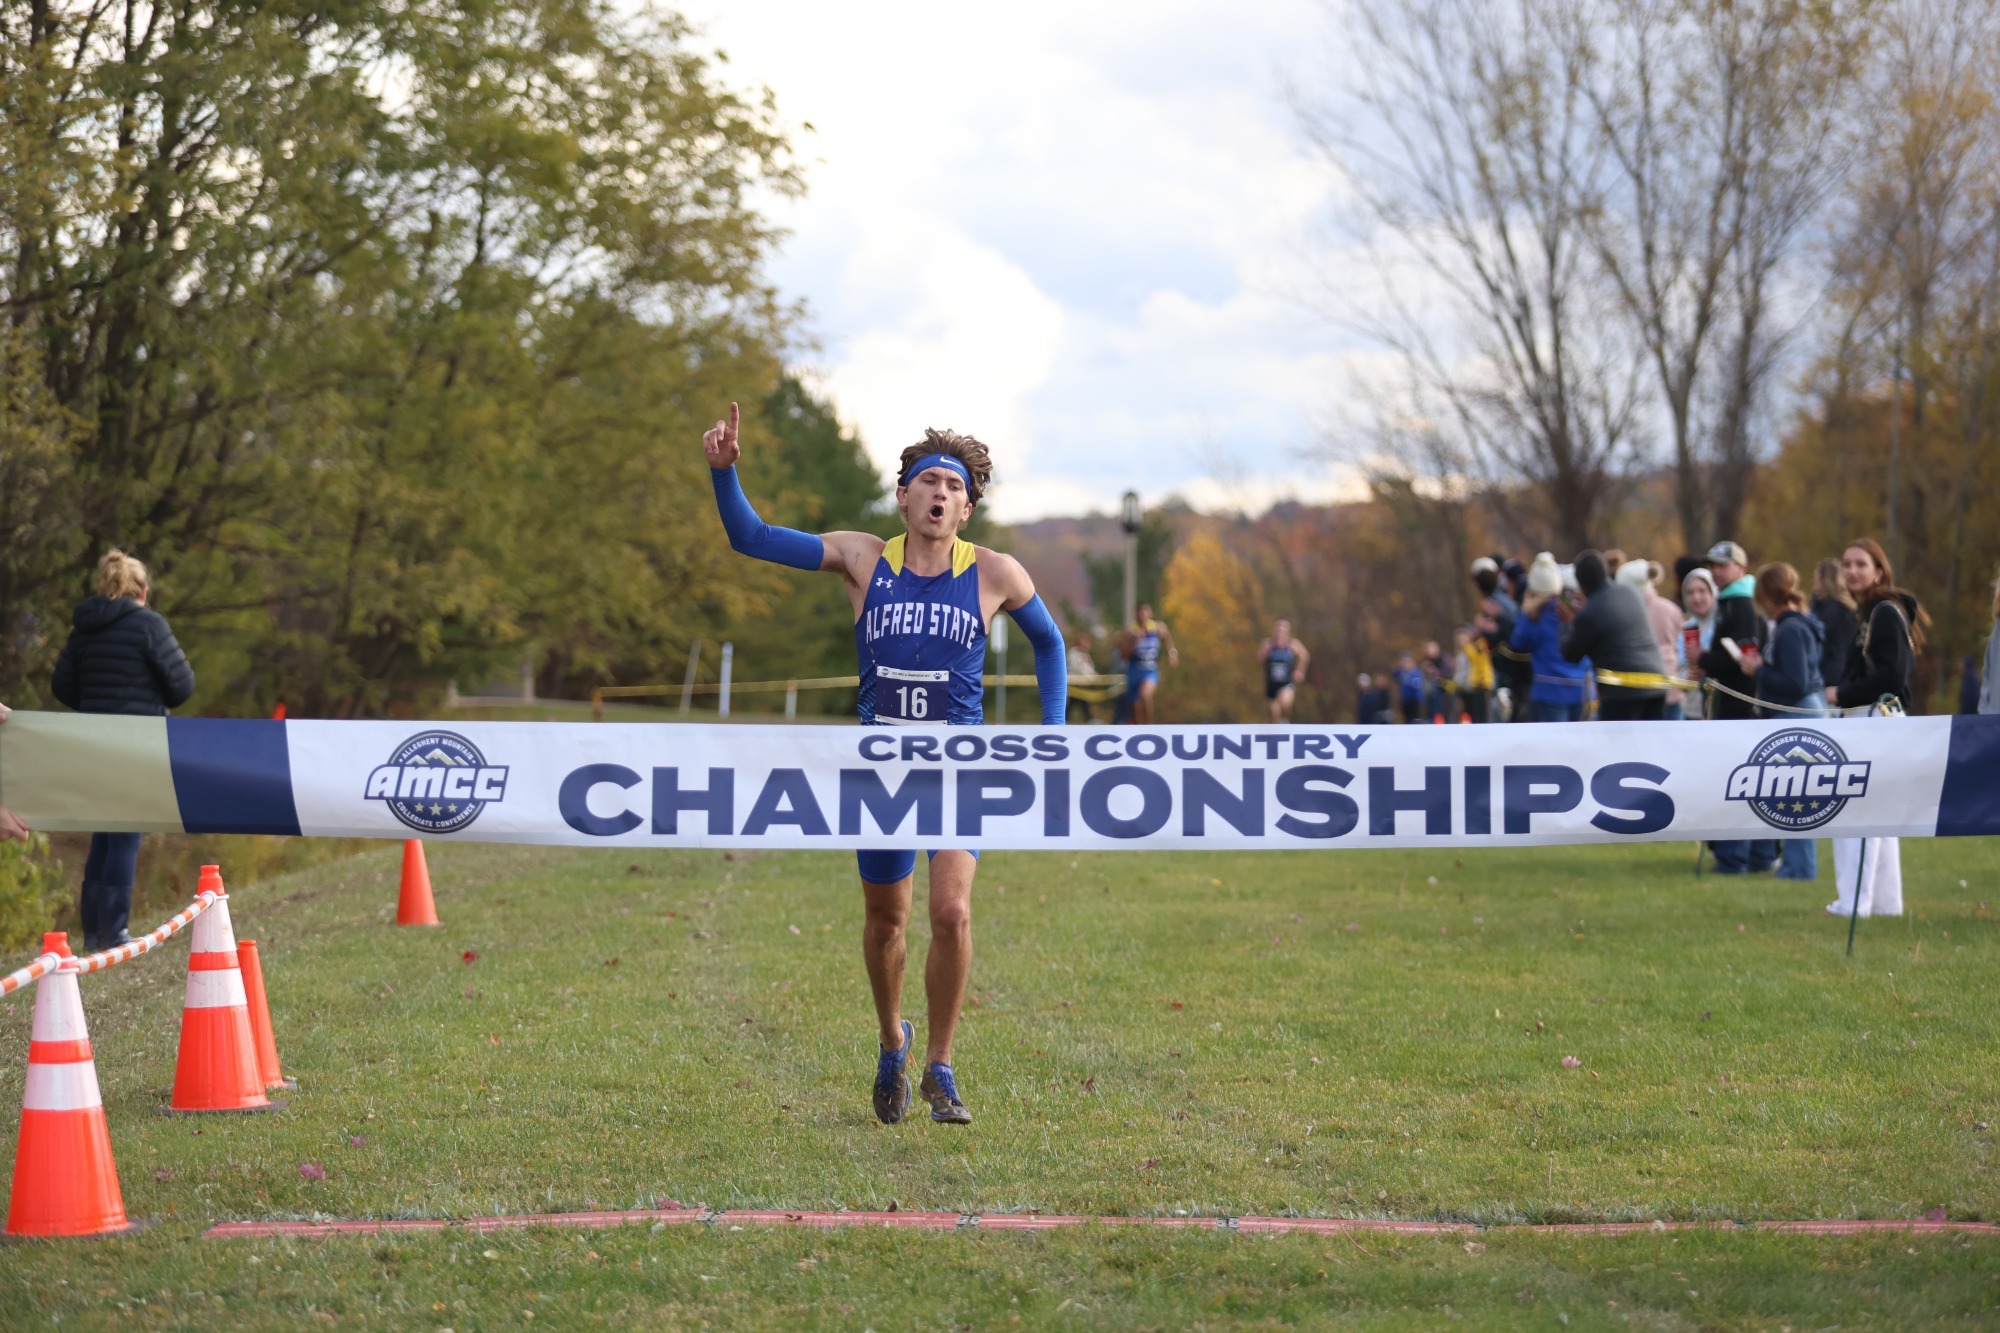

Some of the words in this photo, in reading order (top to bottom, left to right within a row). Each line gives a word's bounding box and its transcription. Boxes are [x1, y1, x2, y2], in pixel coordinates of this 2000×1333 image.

[866, 602, 925, 645] ALFRED
[929, 602, 979, 650] STATE
[896, 686, 928, 719] 16
[402, 737, 440, 760] ALLEGHENY
[442, 738, 474, 761] MOUNTAIN
[857, 734, 1070, 762] CROSS
[1084, 733, 1373, 761] COUNTRY
[1761, 735, 1799, 759] ALLEGHENY
[1801, 735, 1835, 758] MOUNTAIN
[366, 765, 507, 800] AMCC
[1727, 763, 1868, 798] AMCC
[396, 801, 434, 828] COLLEGIATE
[435, 802, 476, 828] CONFERENCE
[558, 761, 1676, 839] CHAMPIONSHIPS
[1757, 800, 1795, 825] COLLEGIATE
[1797, 799, 1838, 825] CONFERENCE
